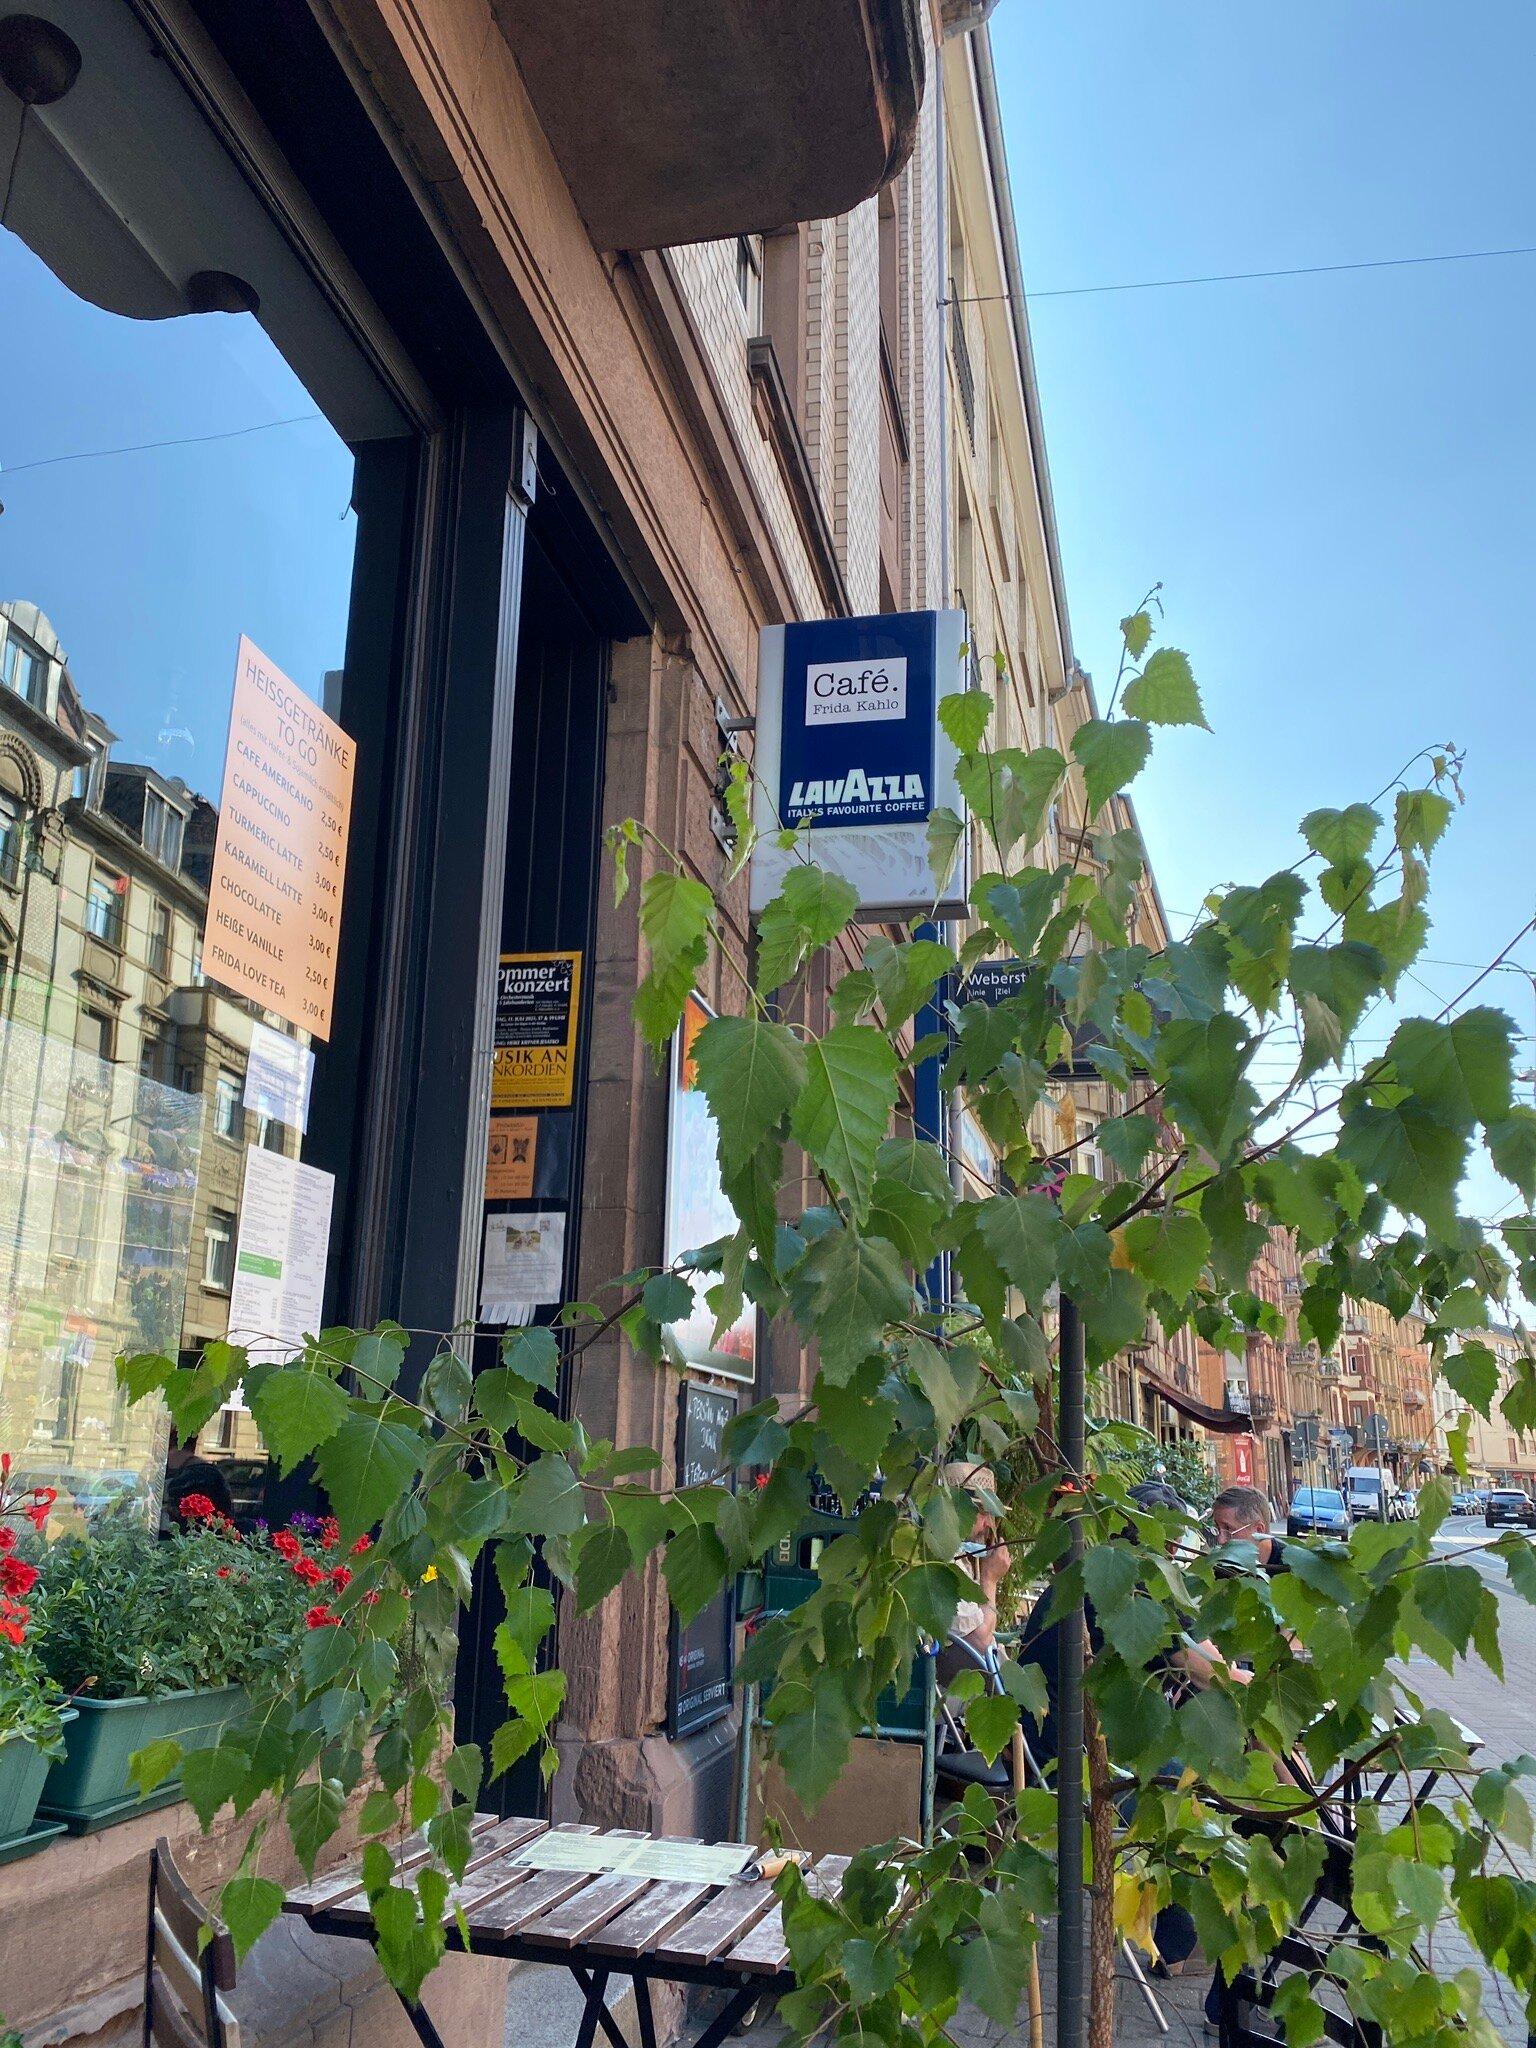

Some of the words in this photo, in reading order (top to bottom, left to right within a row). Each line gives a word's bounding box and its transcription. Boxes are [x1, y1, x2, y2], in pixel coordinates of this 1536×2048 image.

[813, 668, 898, 698] Café.
[245, 658, 348, 769] HEISSGETRÄNKE
[813, 703, 851, 715] Frida
[856, 699, 899, 712] Kahlo
[276, 716, 294, 748] TO
[298, 737, 317, 768] GO
[236, 739, 260, 768] CAFE
[262, 760, 313, 812] AMERICANO
[321, 810, 336, 832] 2,50
[337, 823, 342, 837] €
[788, 808, 824, 818] ITALY'S
[827, 804, 882, 815] FAVOURITE
[885, 801, 925, 812] COFFEE
[789, 768, 925, 806] LAVAZZA
[232, 772, 291, 828] CAPPUCCINO
[318, 841, 333, 862] 2,50
[334, 854, 339, 868] €
[228, 806, 275, 851] TURMERIC
[277, 843, 303, 871] LATTE
[315, 872, 330, 892] 3,00
[331, 884, 337, 898] €
[224, 840, 275, 885] KARAMELL
[276, 877, 302, 905] LATTE
[312, 903, 327, 923] 3,00
[328, 915, 334, 928] €
[220, 874, 282, 925] CHOCOLATTE
[309, 935, 325, 954] 3,00
[325, 945, 331, 959] €
[216, 910, 244, 937] HEIßE
[246, 928, 283, 961] VANILLE
[306, 966, 321, 985] 2,50
[322, 976, 327, 990] €
[212, 945, 241, 972] FRIDA
[243, 963, 267, 987] LOVE
[269, 978, 286, 998] TEA
[302, 999, 318, 1018] 3,00
[319, 1009, 324, 1022] €
[498, 967, 556, 980] ommer
[504, 976, 570, 993] konzert
[968, 972, 1027, 986] Weberst
[493, 1064, 567, 1077] NKORDIEN
[494, 1050, 534, 1065] USIK
[541, 1049, 568, 1063] AN
